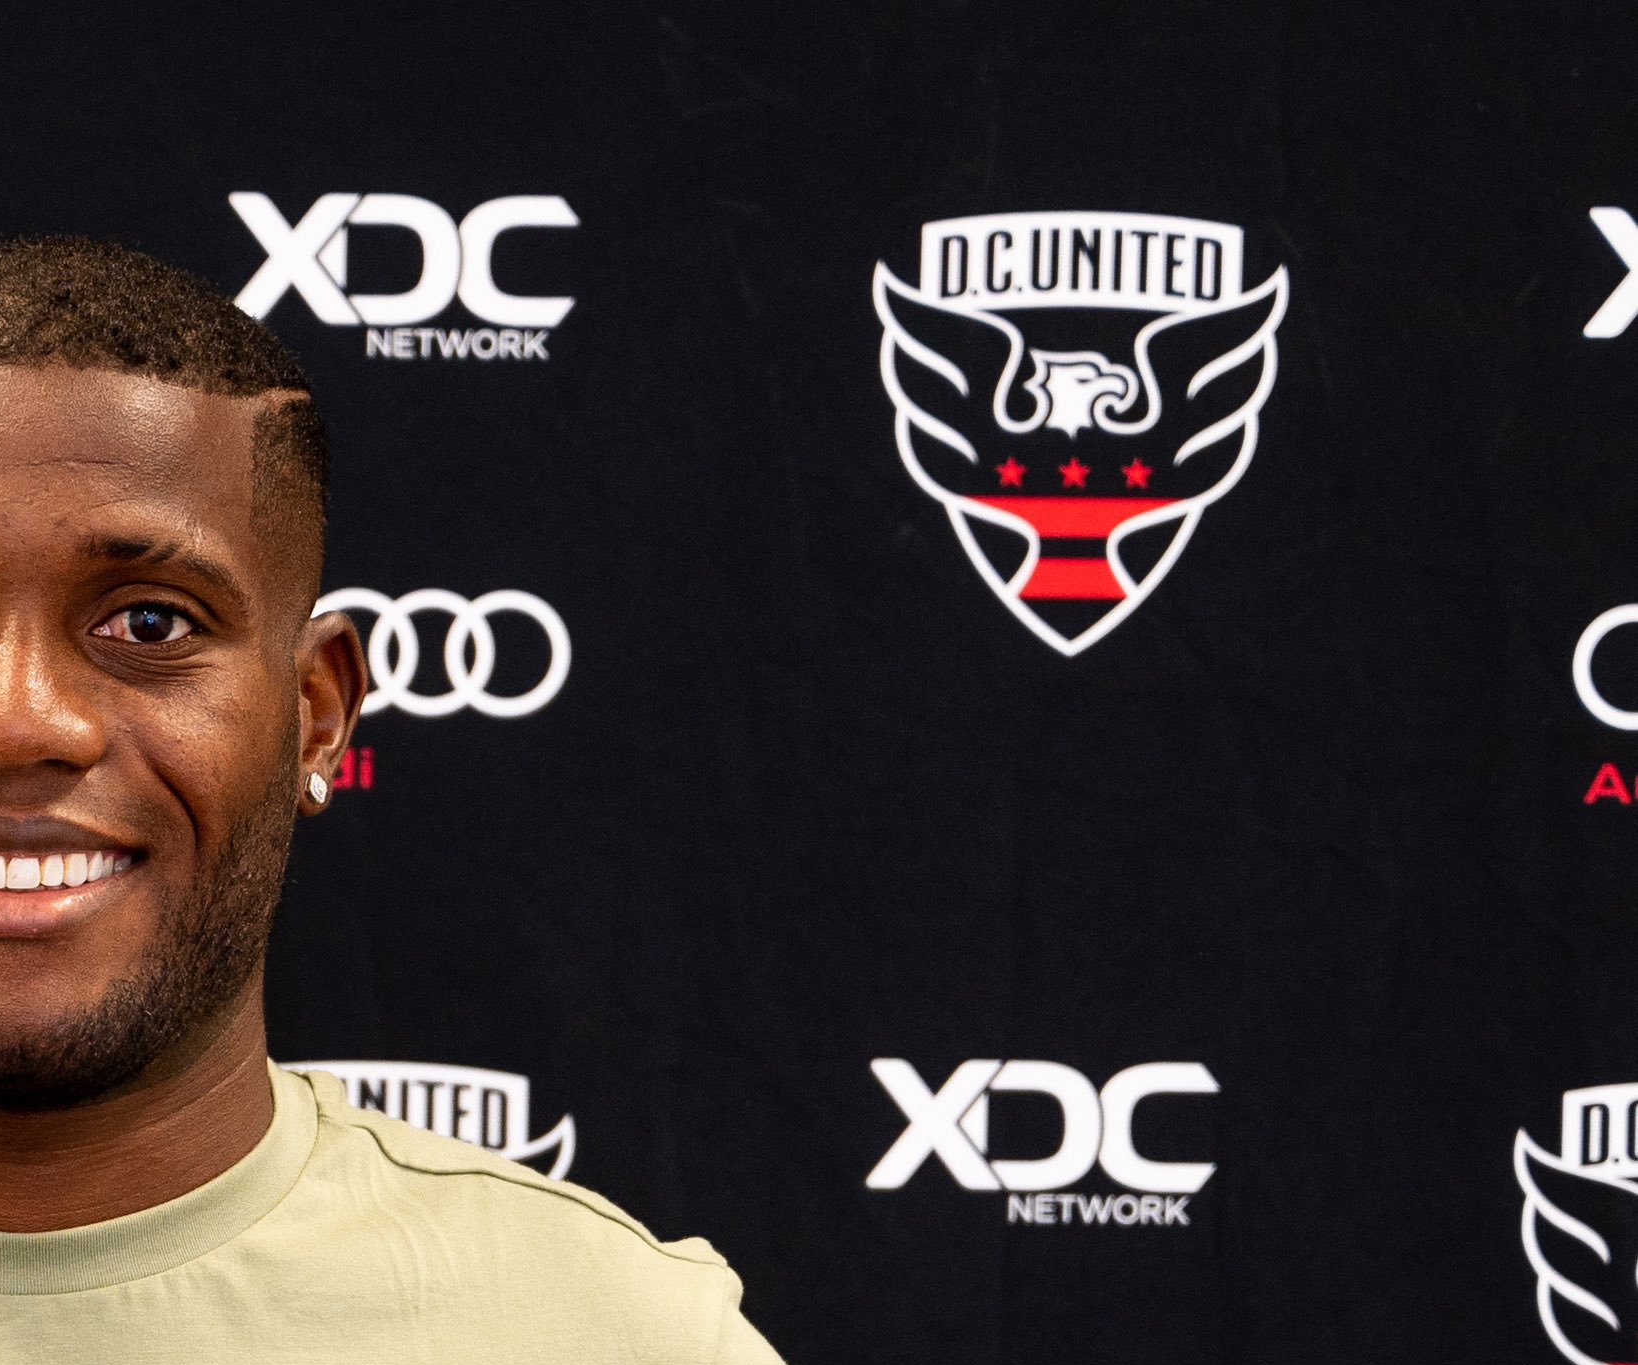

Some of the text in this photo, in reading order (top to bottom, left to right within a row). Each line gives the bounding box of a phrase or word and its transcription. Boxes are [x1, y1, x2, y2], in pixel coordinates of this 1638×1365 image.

[228, 191, 581, 327] XDC
[366, 328, 549, 360] NETWORK
[864, 1057, 1220, 1193] XDC
[1008, 1194, 1190, 1226] NETWORK
